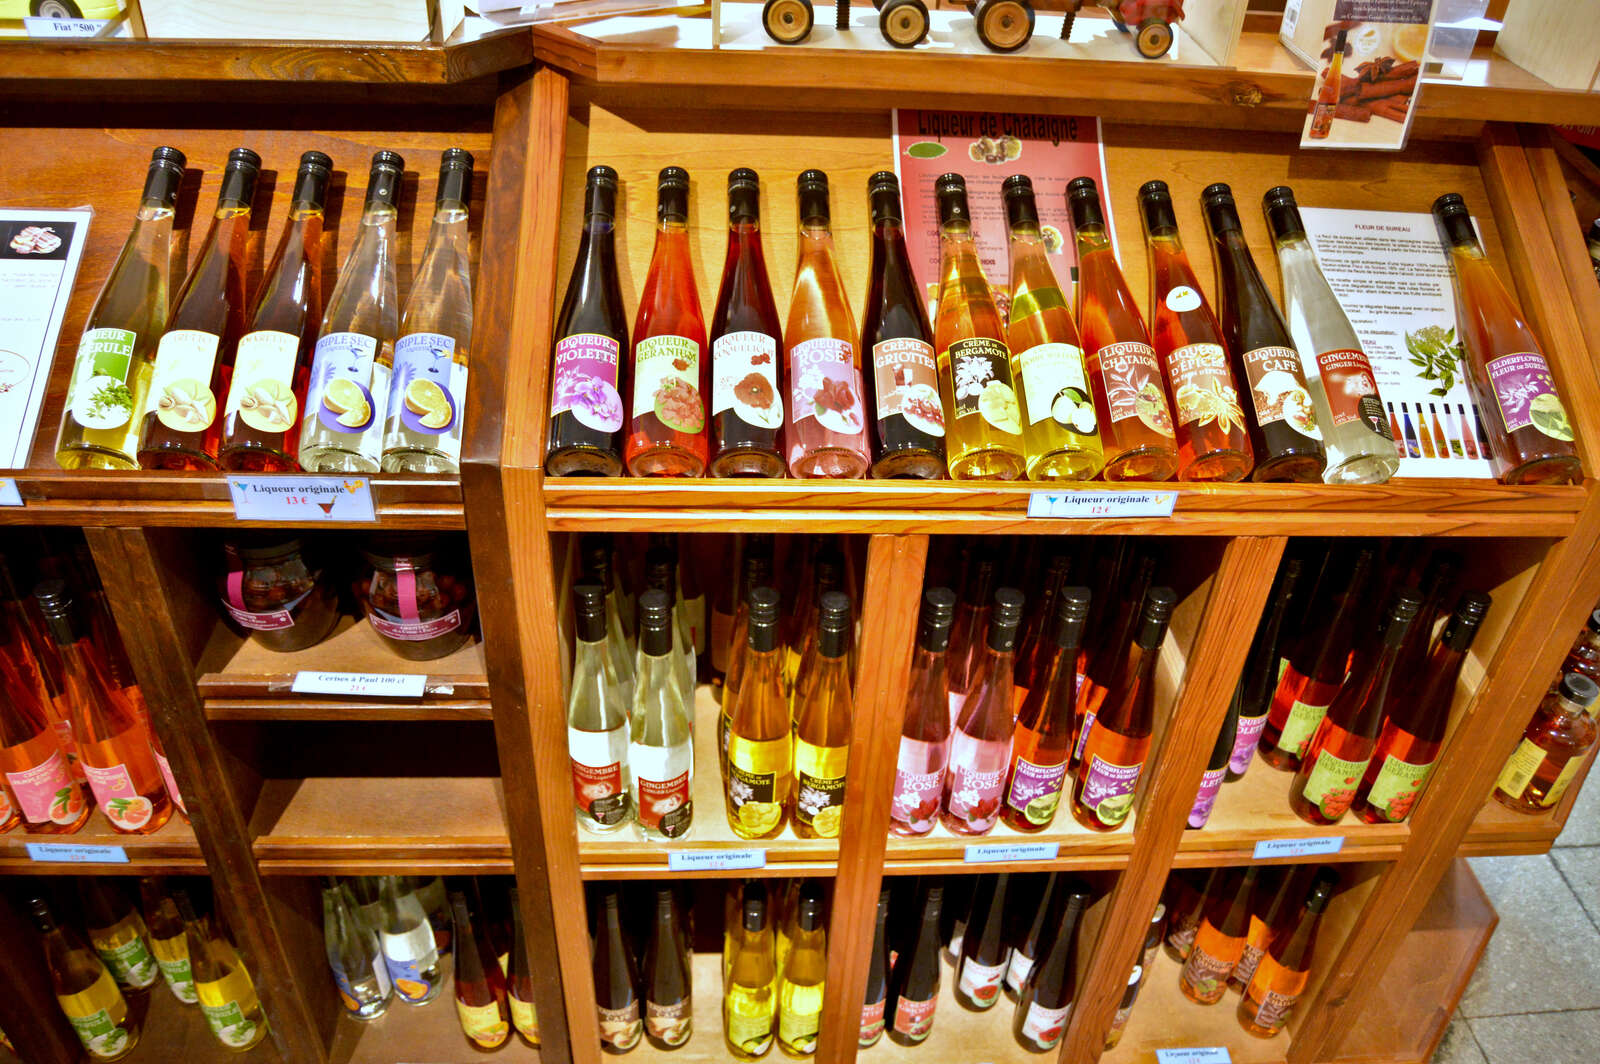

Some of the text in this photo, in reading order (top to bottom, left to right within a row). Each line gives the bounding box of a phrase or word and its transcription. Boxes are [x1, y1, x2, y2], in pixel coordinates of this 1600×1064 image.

[53, 22, 71, 31] Fiat
[917, 109, 974, 142] Liqueur
[979, 111, 997, 137] de
[429, 336, 452, 348] SEC
[560, 335, 610, 351] LIQUEUR
[639, 336, 688, 352] LIQUEUR
[717, 333, 766, 349] LIQUEUR
[556, 348, 617, 366] VIOLETTE
[799, 348, 846, 369] ROSE
[955, 346, 1007, 360] BERGAMOTE
[1247, 348, 1295, 363] LIQUEUR
[876, 351, 937, 370] GRIOTTES
[1325, 360, 1353, 372] GINGER
[1492, 365, 1515, 379] FLEUR
[253, 484, 345, 494] Liqueur originale
[286, 496, 308, 505] 13 €
[1064, 495, 1150, 505] Liqueur originale
[1091, 506, 1101, 514] 12
[358, 676, 379, 684] Paul
[1017, 766, 1035, 778] FLEUR
[1092, 763, 1110, 778] FLEUR
[640, 775, 688, 789] GINGEMBRE
[903, 779, 940, 792] ROSE
[963, 777, 1001, 790] ROSE
[716, 853, 752, 861] originale
